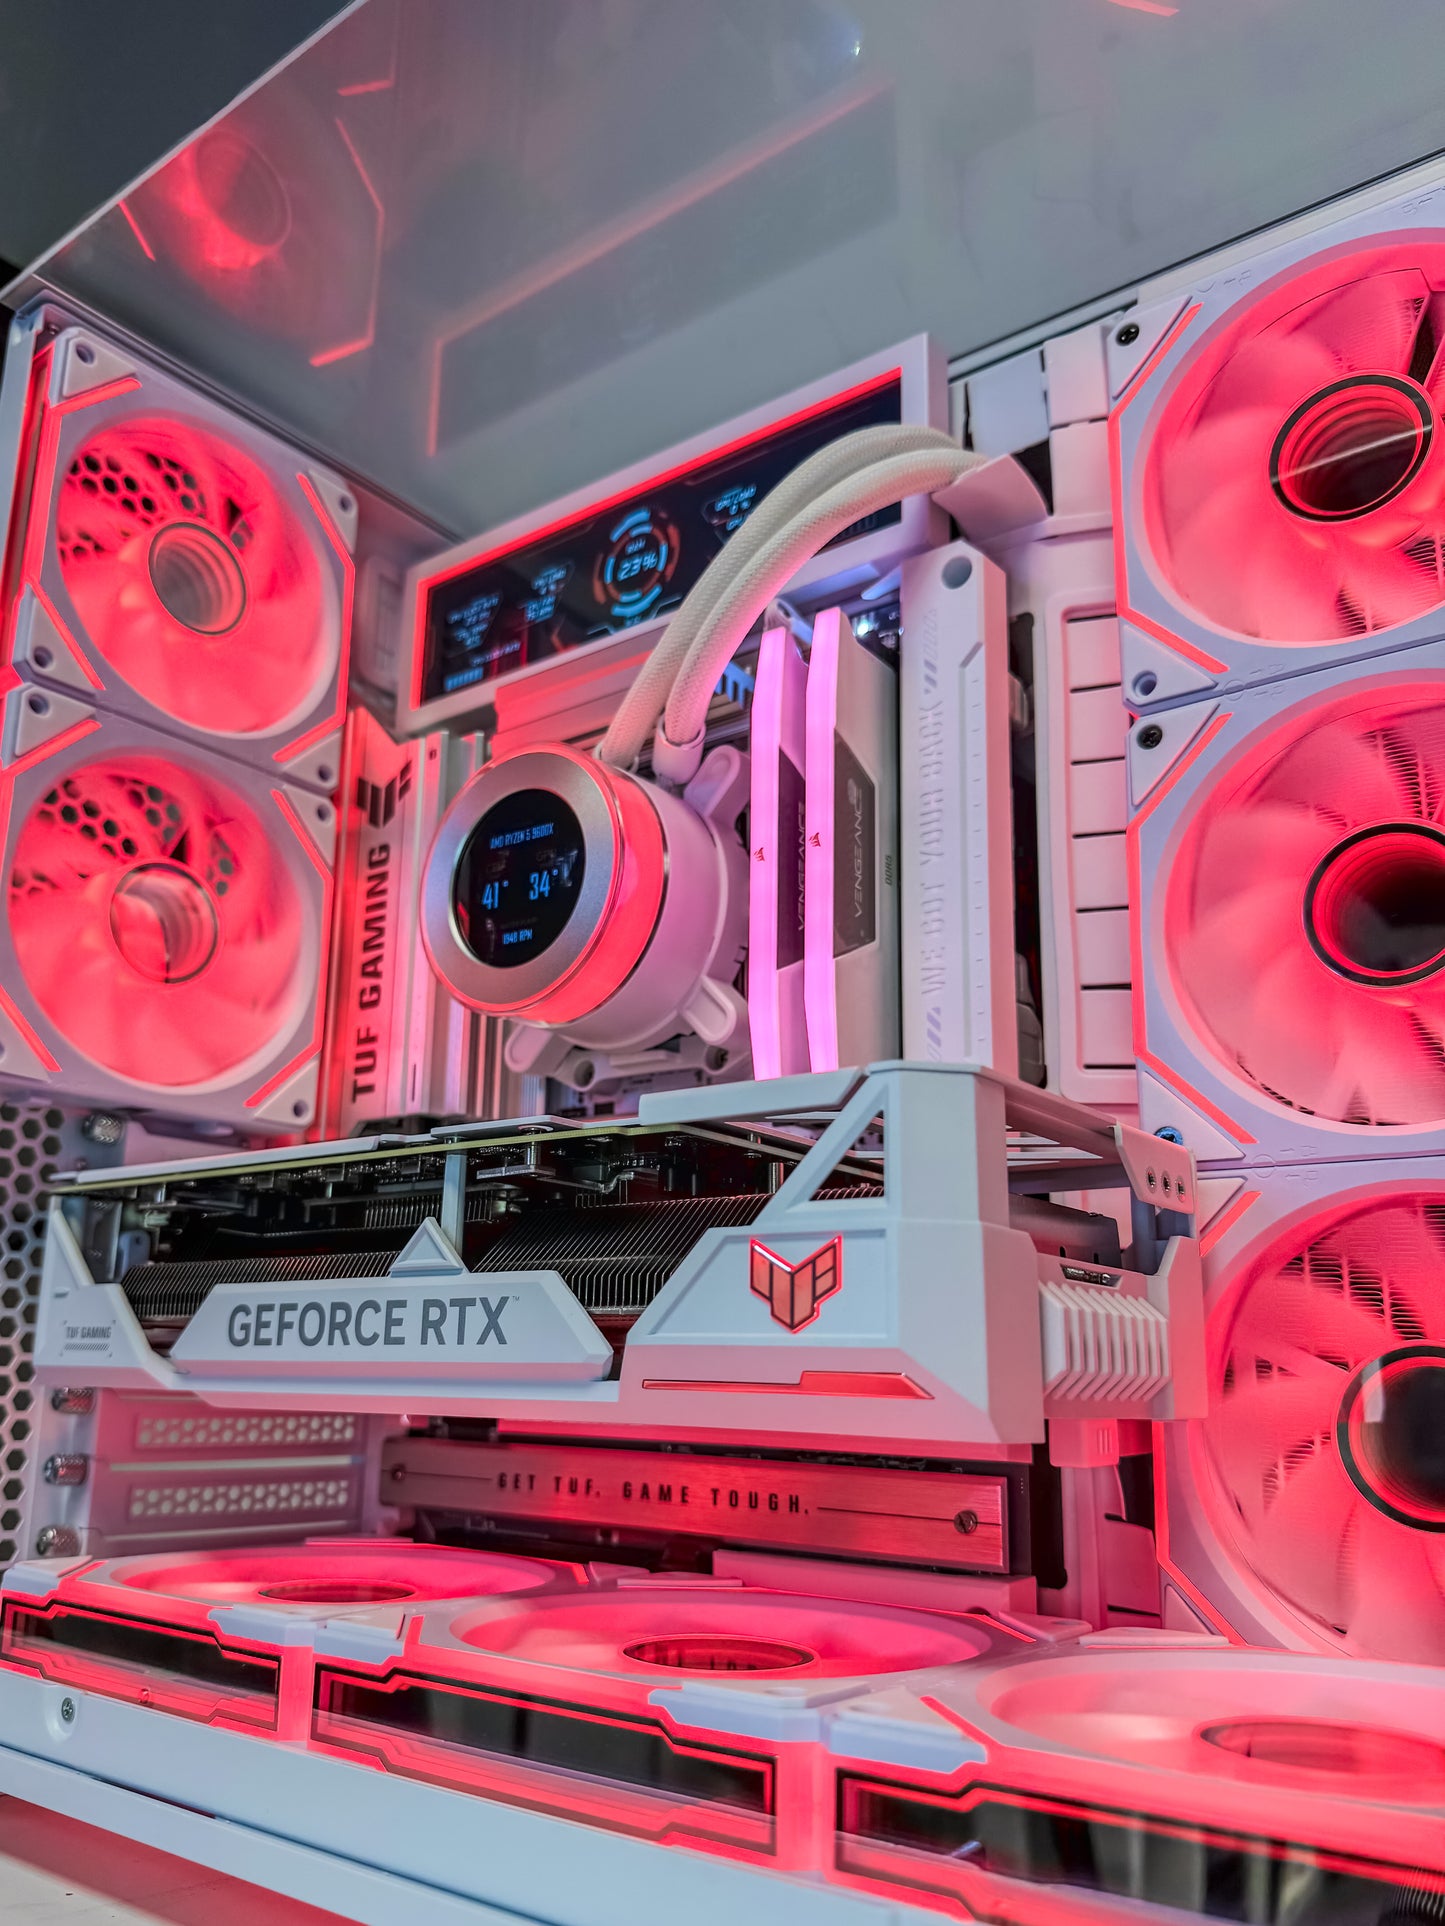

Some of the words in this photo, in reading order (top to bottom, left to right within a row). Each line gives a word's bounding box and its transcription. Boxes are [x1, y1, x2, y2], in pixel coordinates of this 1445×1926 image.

[919, 700, 944, 778] BACK
[490, 835, 504, 850] AMD
[505, 830, 525, 846] RYZEN
[526, 828, 531, 841] 5
[919, 789, 945, 866] YOUR
[854, 786, 863, 918] VENGEANCE
[884, 854, 893, 887] DDR5
[359, 842, 391, 1012] GAMING
[919, 882, 945, 935] GOT
[519, 928, 533, 942] RPM
[920, 947, 946, 995] WE
[352, 1026, 378, 1104] TUF
[66, 1326, 79, 1339] TUF
[80, 1326, 112, 1339] GAMING
[228, 1299, 408, 1347] GEFORCE
[497, 1471, 536, 1491] GET
[622, 1481, 690, 1504] GAME
[711, 1487, 809, 1515] TOUGH.
